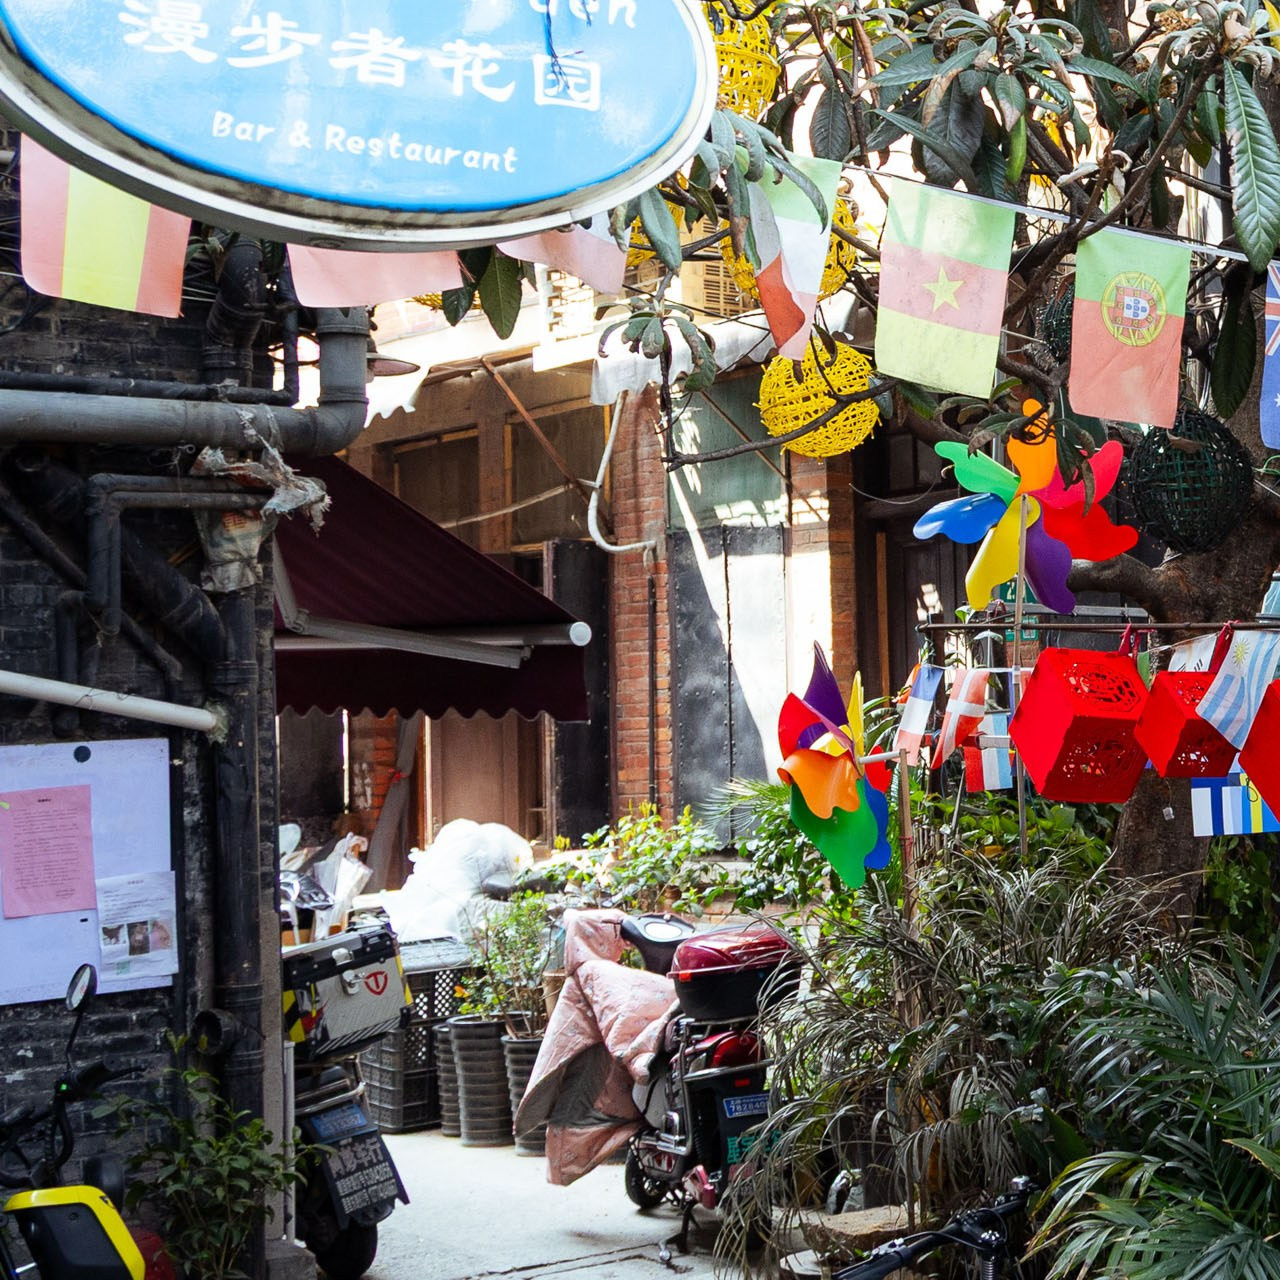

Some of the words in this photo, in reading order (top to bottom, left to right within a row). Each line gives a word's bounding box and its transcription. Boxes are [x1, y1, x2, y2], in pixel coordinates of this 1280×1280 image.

[213, 110, 276, 144] Bar
[288, 121, 312, 149] &
[325, 124, 520, 174] Restaurant
